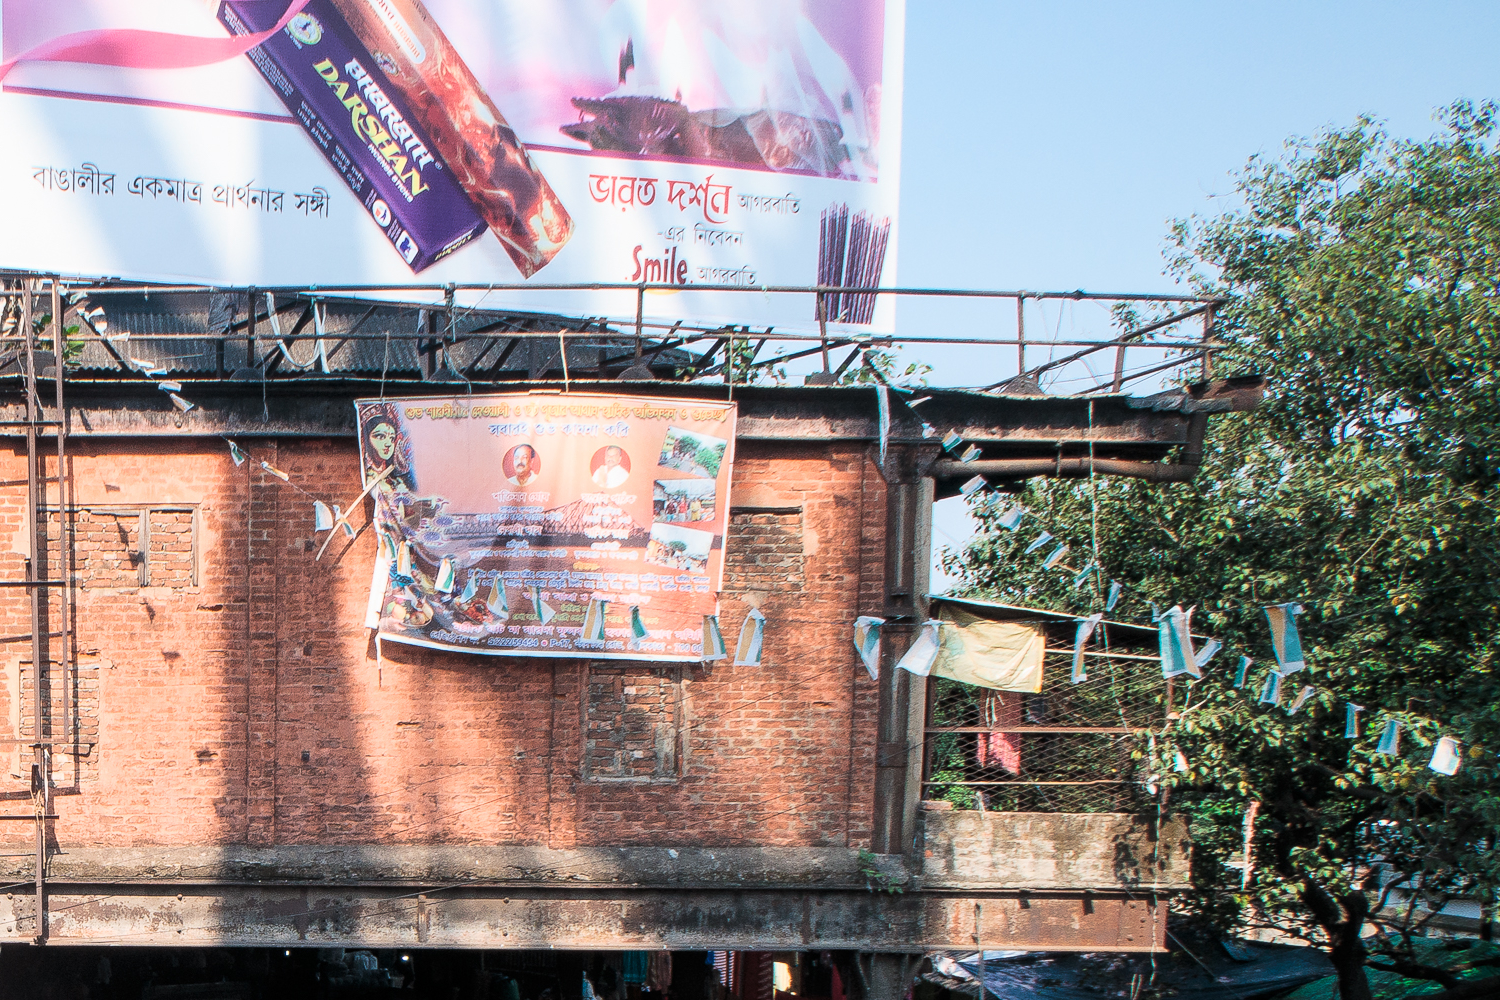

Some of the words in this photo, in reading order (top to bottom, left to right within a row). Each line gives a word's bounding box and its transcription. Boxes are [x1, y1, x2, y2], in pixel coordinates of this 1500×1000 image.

[312, 57, 430, 197] DARSHAN
[367, 143, 392, 177] INCENSE
[32, 162, 117, 196] বাঙালীর
[127, 176, 203, 205] একমাত্র
[212, 178, 285, 213] প্রার্থনার
[293, 187, 331, 218] সঙ্গী
[588, 174, 658, 212] ভারত
[666, 174, 733, 224] দর্শন
[737, 192, 801, 215] আগরবাতি
[693, 222, 744, 246] নিবেদন
[696, 265, 757, 286] আগরবাতি
